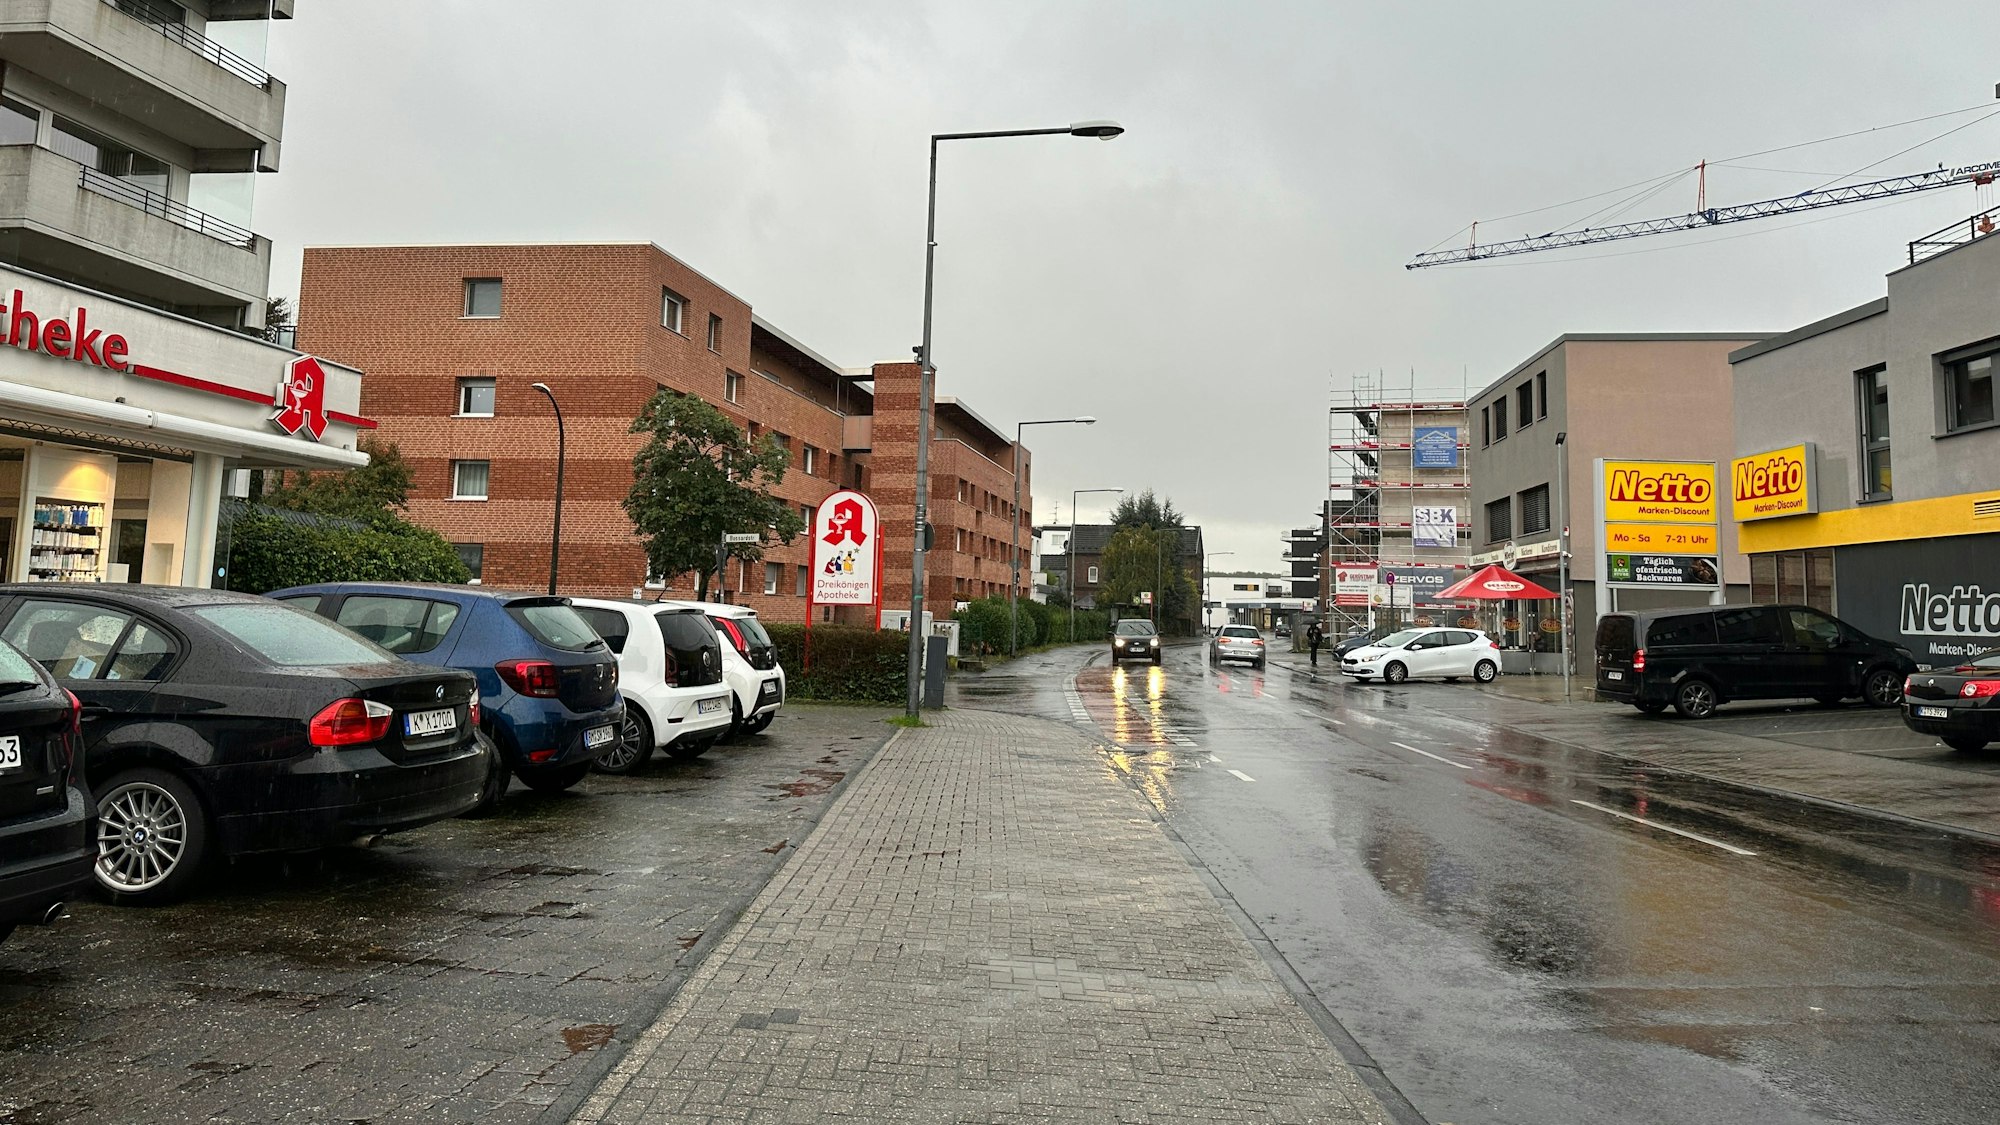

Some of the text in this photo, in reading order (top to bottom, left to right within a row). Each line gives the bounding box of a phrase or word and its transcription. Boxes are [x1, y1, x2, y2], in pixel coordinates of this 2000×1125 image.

[1736, 456, 1803, 501] Netto
[1609, 469, 1711, 503] Netto
[1638, 506, 1710, 515] Marken-Discount
[1753, 498, 1803, 513] Marken-Discount
[1415, 508, 1454, 523] SBK
[1614, 533, 1629, 542] Mo
[1638, 534, 1651, 543] Sa
[1666, 534, 1686, 544] 7-21
[1691, 535, 1708, 544] Uhr
[1643, 557, 1675, 567] Täglich
[1635, 565, 1683, 575] ofenfrische
[1394, 575, 1444, 584] ZERVOS
[1636, 574, 1683, 582] Backwaren
[817, 579, 870, 591] Dreikönigen
[816, 590, 860, 601] Apotheke
[1901, 584, 2000, 637] Netto
[413, 714, 421, 731] K
